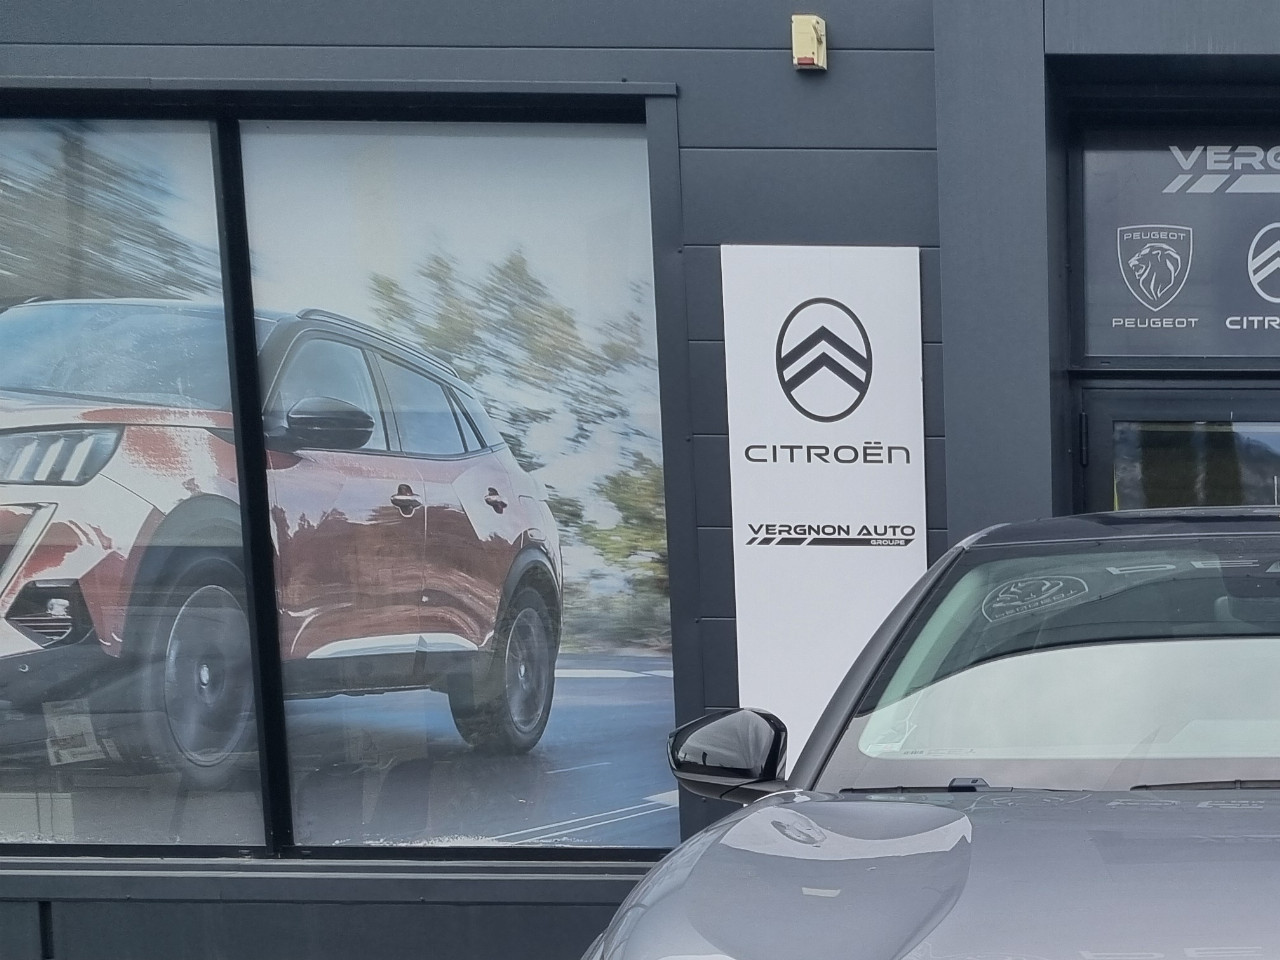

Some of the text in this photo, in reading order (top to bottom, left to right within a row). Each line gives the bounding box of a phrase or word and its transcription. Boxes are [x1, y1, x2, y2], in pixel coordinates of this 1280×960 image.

[1123, 231, 1187, 242] PEUGEOT
[1112, 317, 1199, 328] PEUGEOT
[747, 523, 916, 537] VERGNON AUTO
